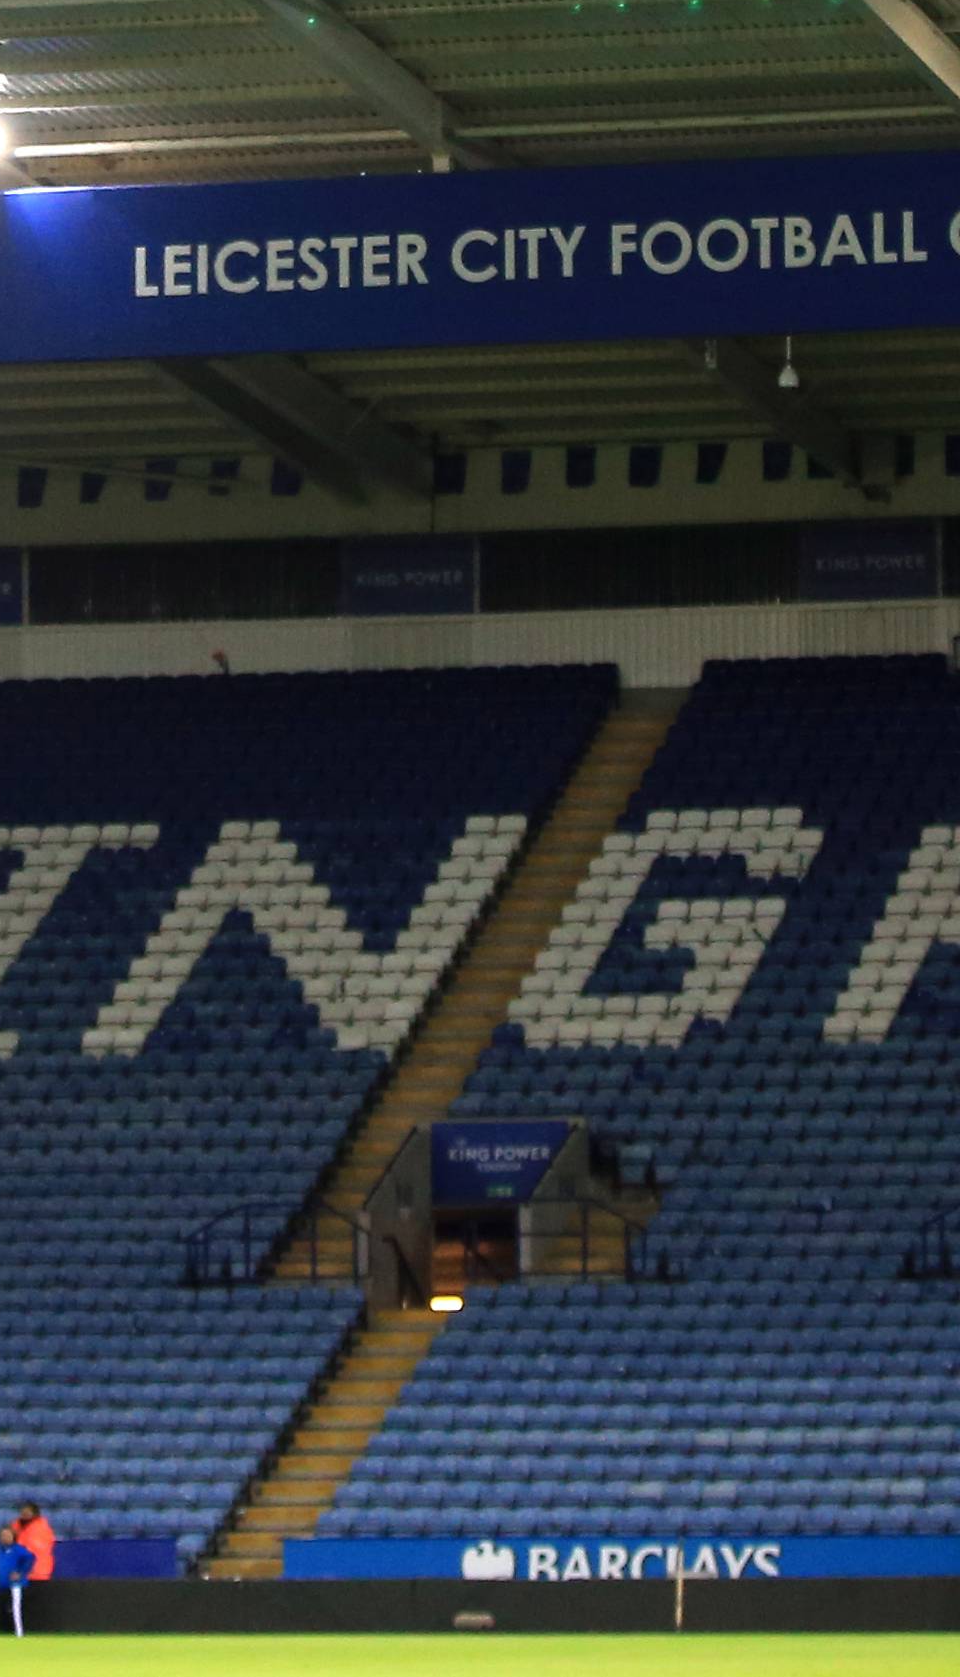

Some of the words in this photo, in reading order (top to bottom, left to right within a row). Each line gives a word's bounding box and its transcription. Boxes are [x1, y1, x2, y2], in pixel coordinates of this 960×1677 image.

[134, 233, 429, 298] LEICESTER
[451, 225, 586, 284] CITY
[610, 211, 928, 276] FOOTBALL
[449, 1147, 490, 1162] KING
[494, 1145, 550, 1161] POWER
[528, 1543, 781, 1581] BARCLAYS
